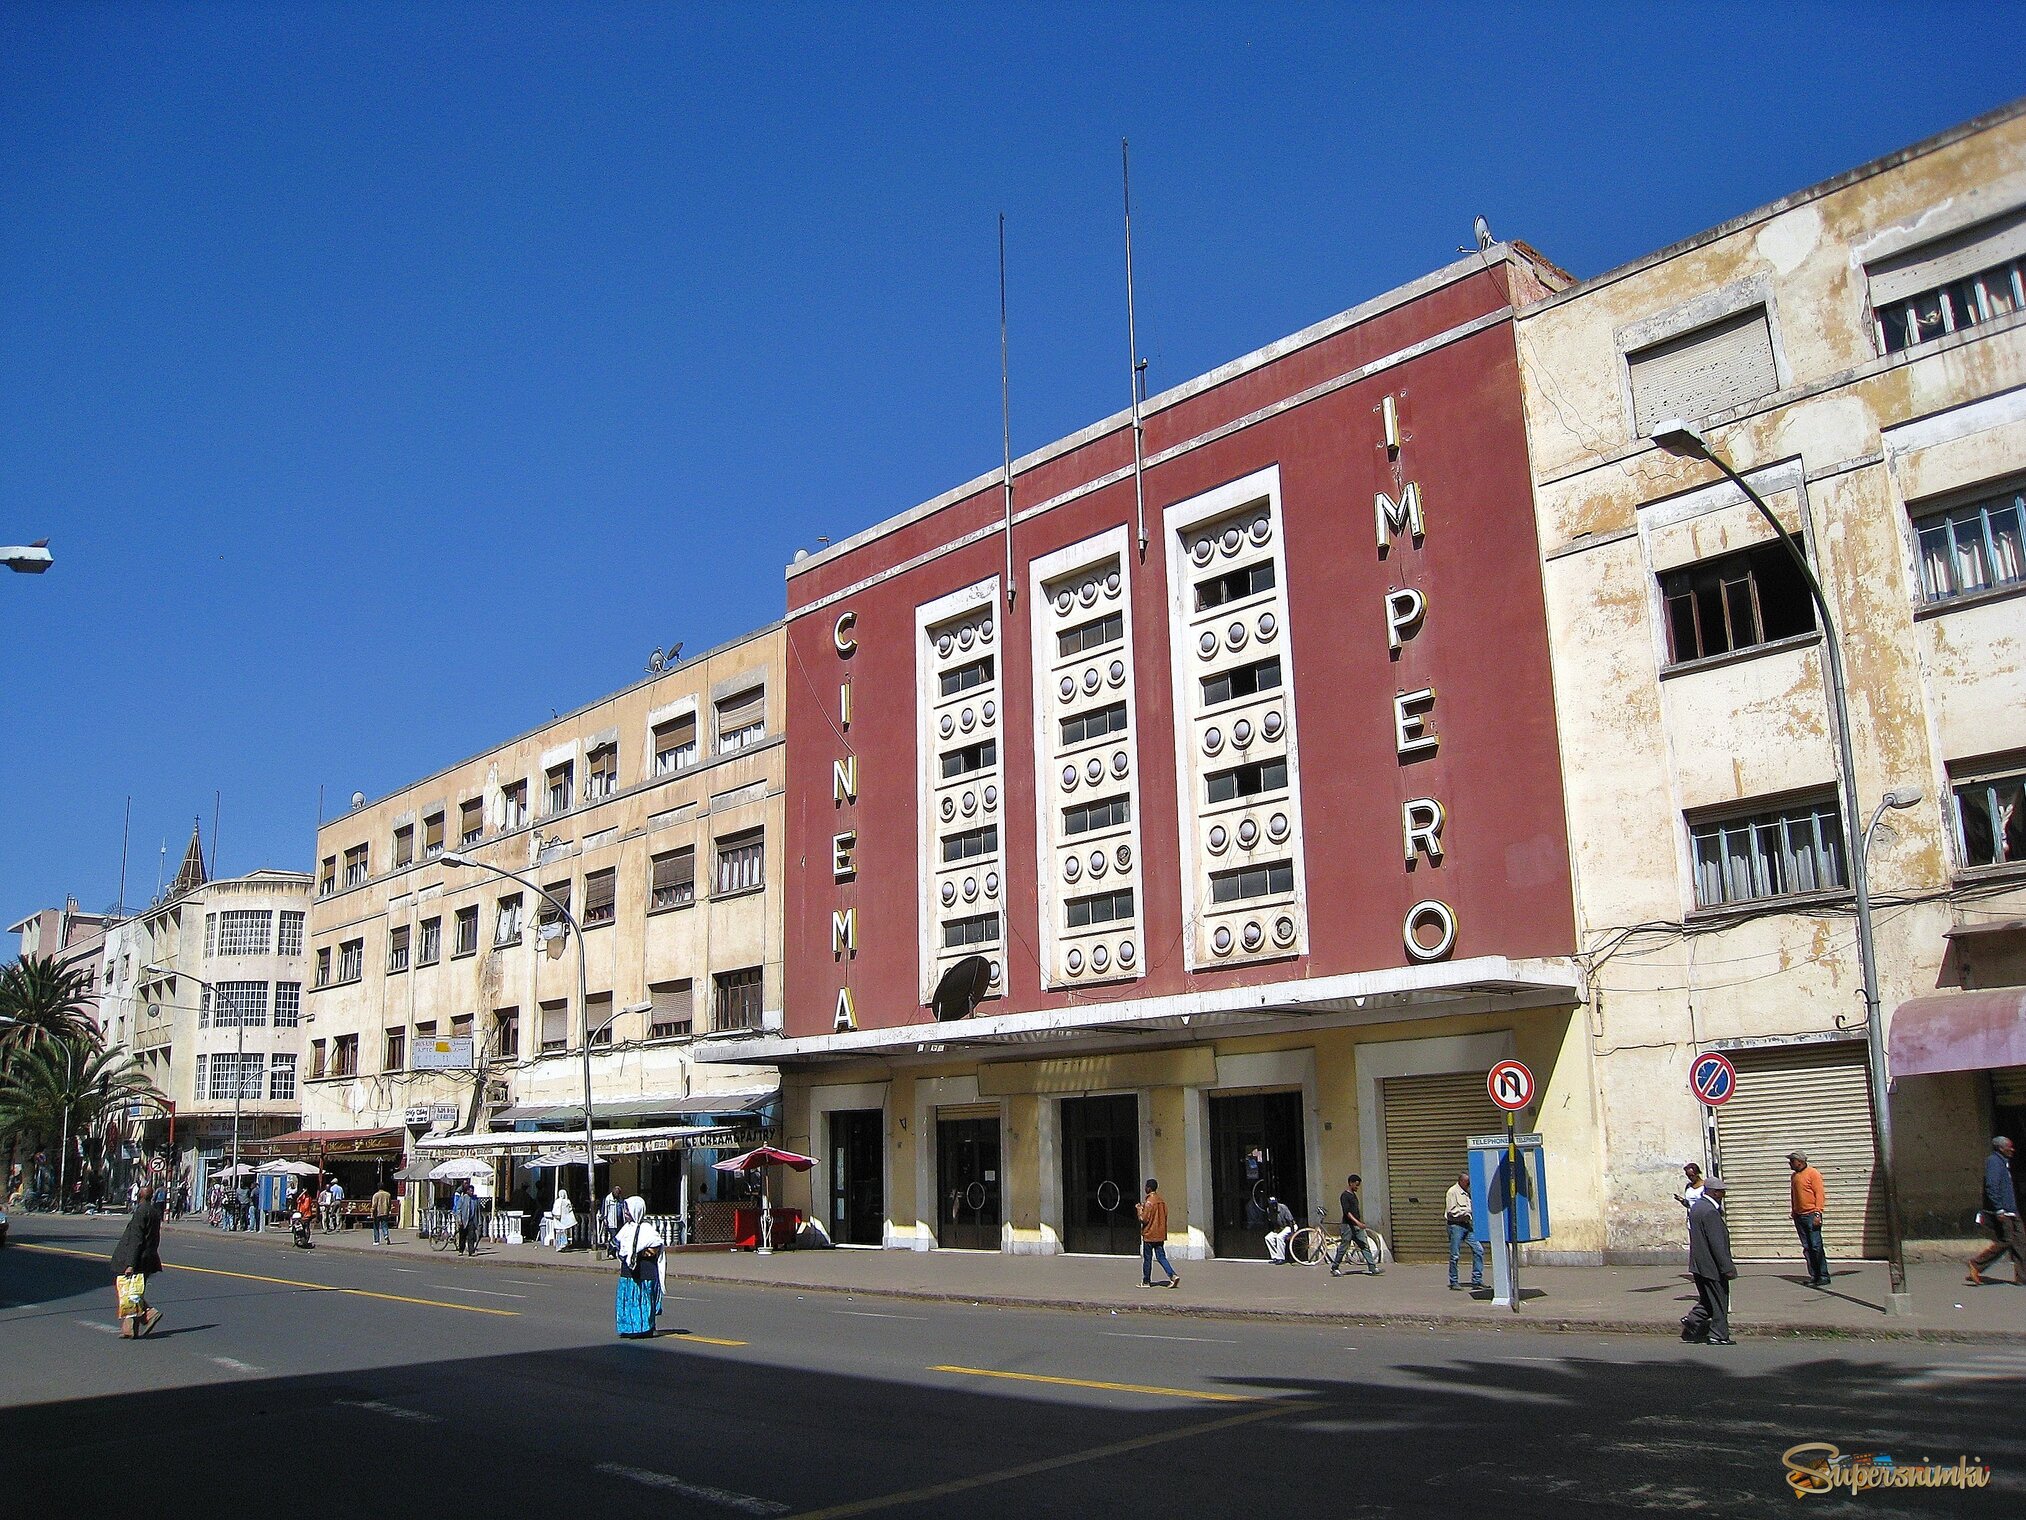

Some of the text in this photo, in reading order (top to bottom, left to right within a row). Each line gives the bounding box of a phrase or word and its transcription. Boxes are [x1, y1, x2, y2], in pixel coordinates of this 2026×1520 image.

[832, 611, 858, 1034] CINEMA
[1374, 394, 1458, 965] IMPERO
[682, 1135, 699, 1147] ICE
